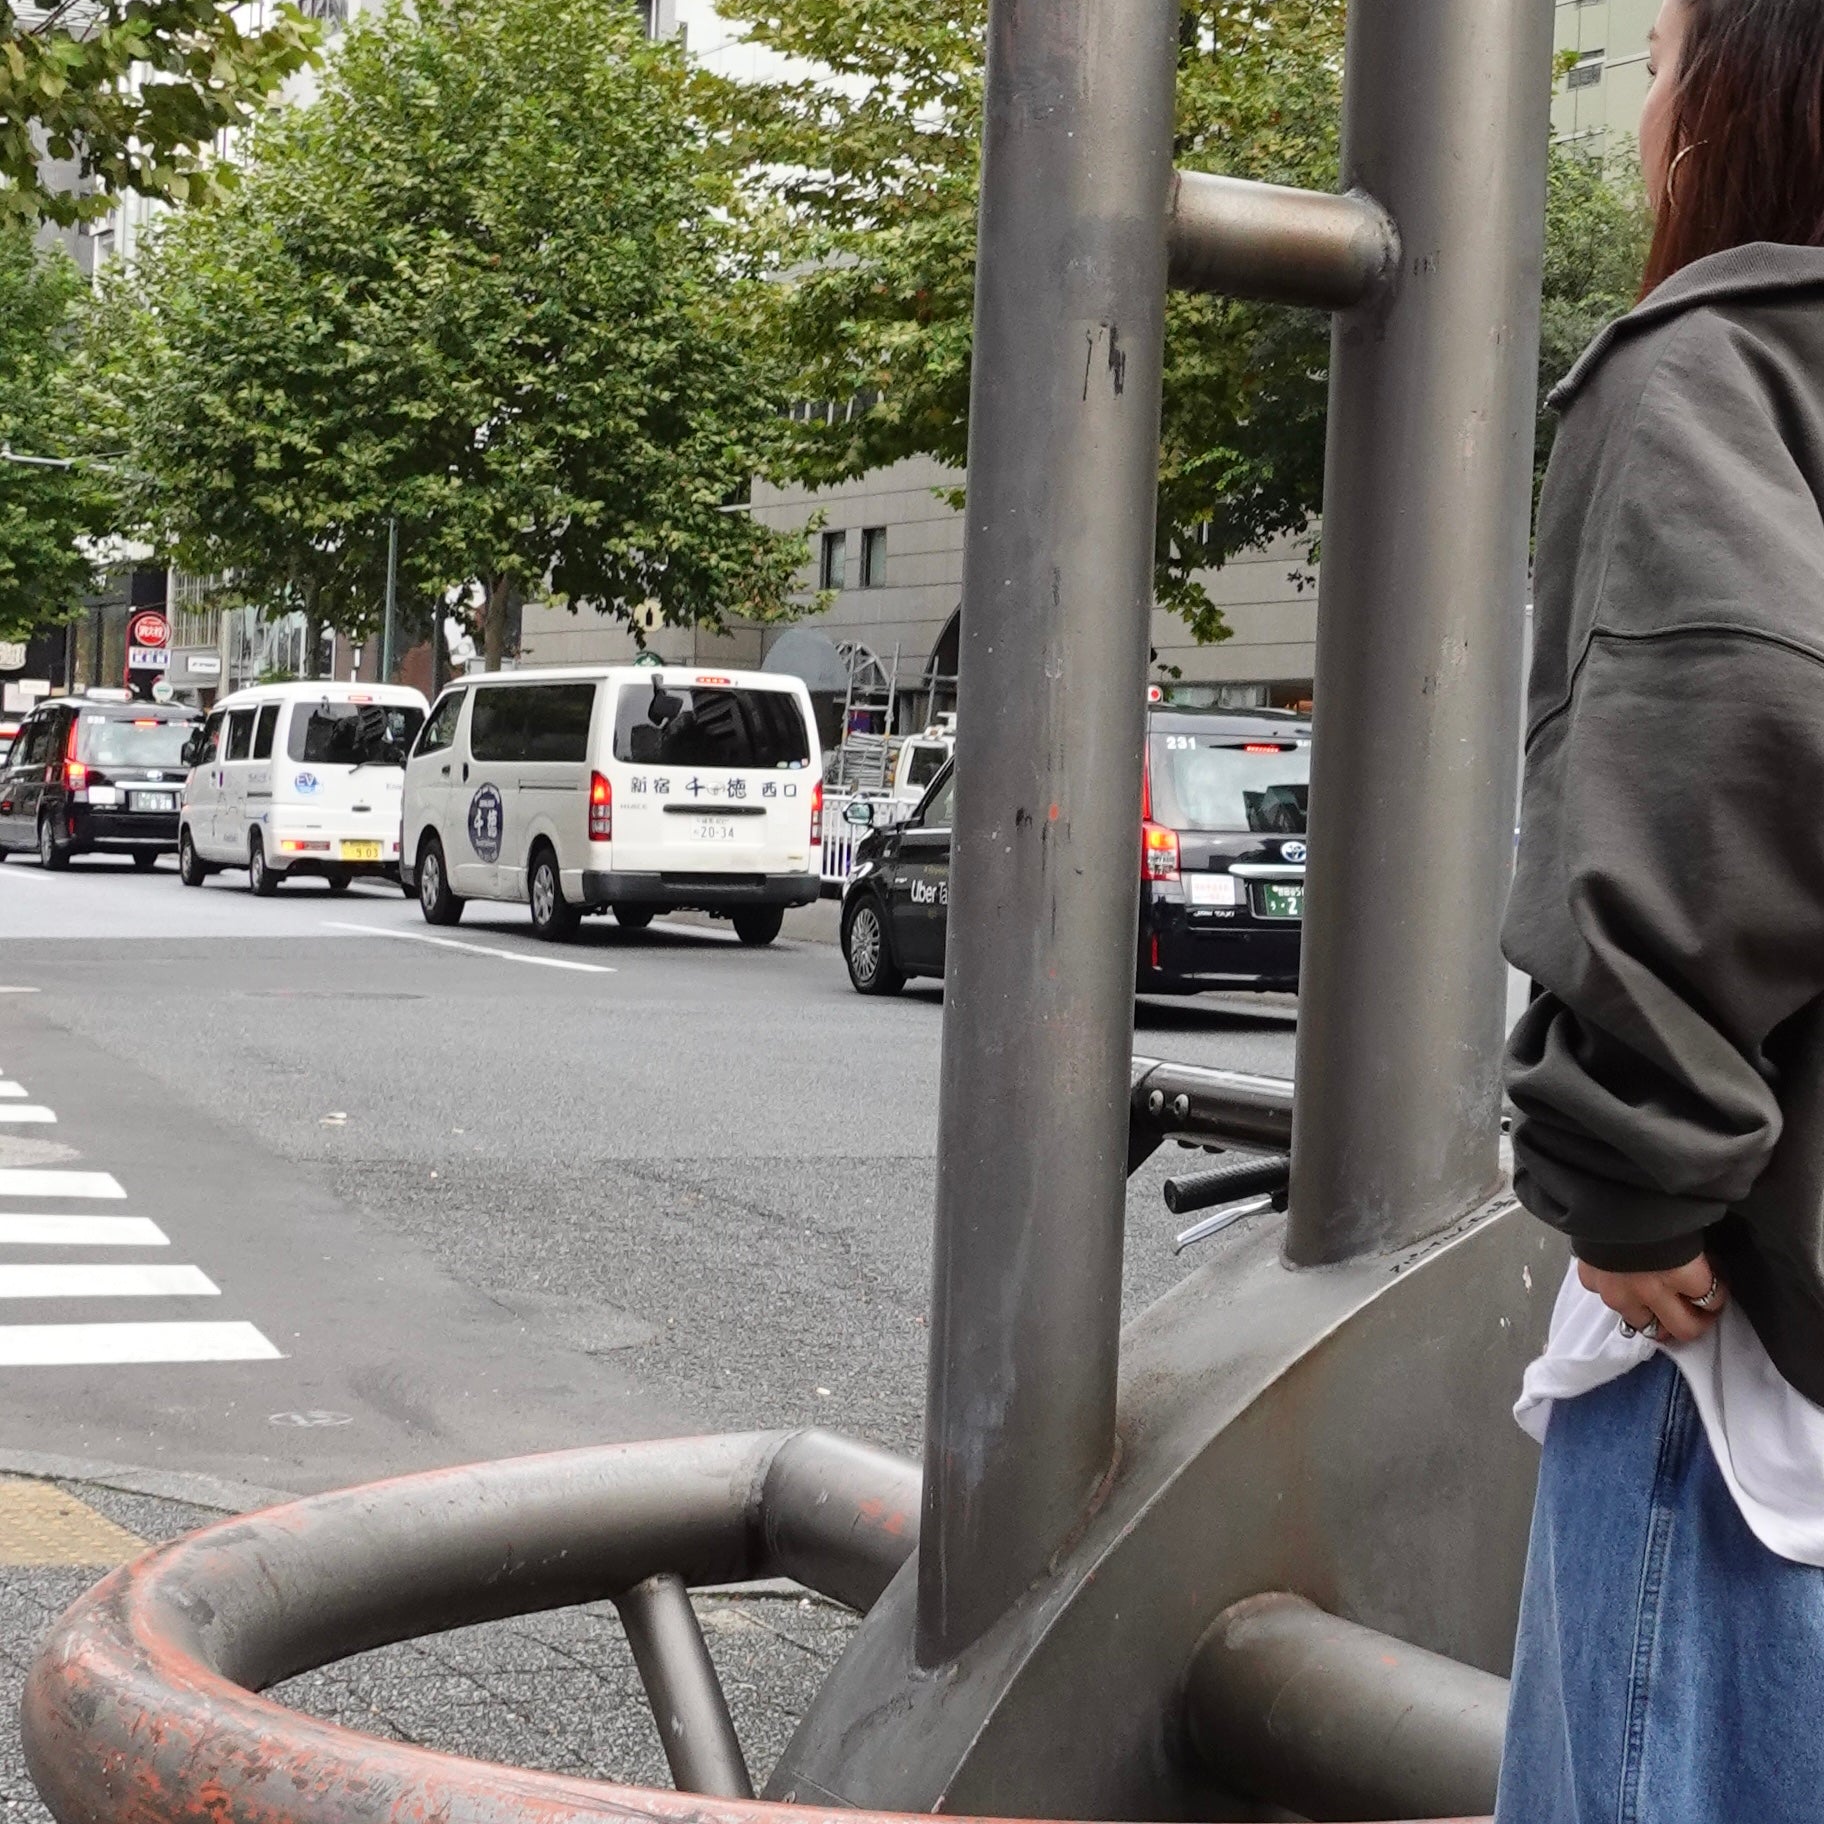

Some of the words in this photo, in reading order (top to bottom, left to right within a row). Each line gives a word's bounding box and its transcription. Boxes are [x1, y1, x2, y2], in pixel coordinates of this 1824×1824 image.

[1166, 736, 1197, 750] 231
[297, 773, 316, 787] EV
[631, 776, 670, 794] 新宿
[762, 781, 797, 798] 西口
[911, 879, 937, 903] Uber
[939, 881, 948, 905] Ta
